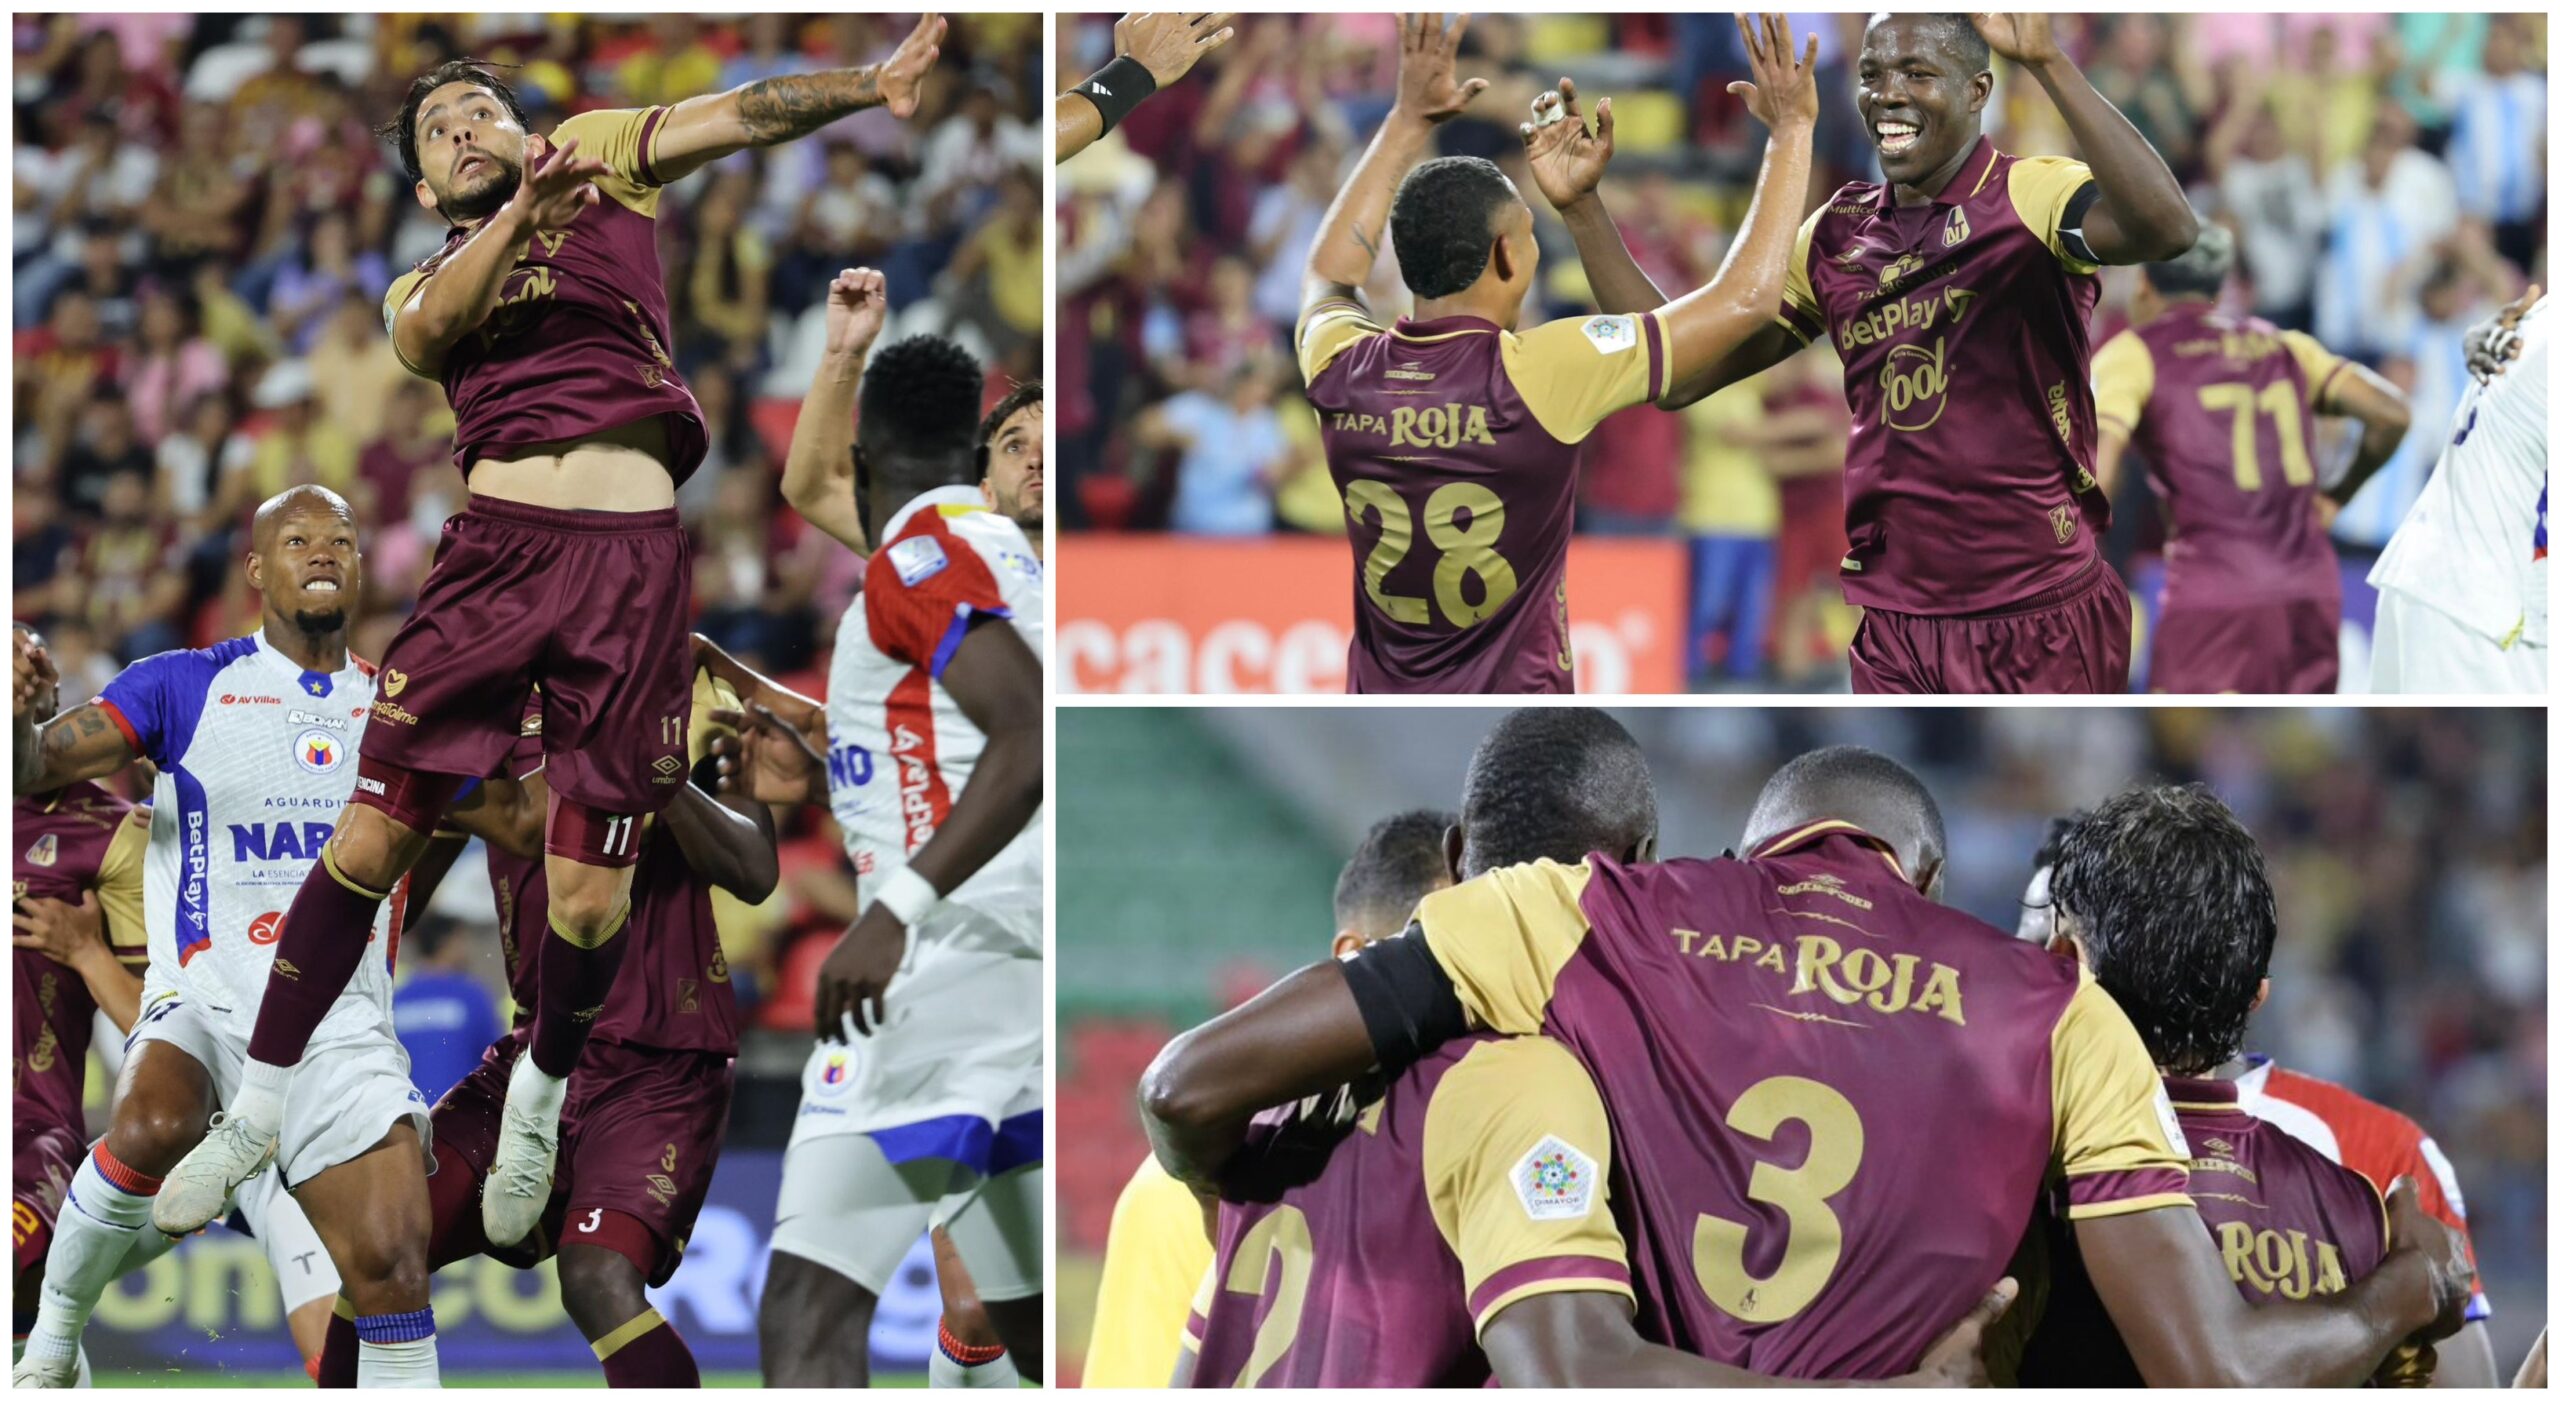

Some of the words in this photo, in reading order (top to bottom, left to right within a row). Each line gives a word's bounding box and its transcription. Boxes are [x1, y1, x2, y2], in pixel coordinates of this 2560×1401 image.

[1841, 297, 1940, 350] BetPlay
[1880, 336, 1949, 425] Pool
[1333, 412, 1387, 436] TAPA
[1389, 402, 1497, 448] ROJA
[2199, 379, 2315, 492] 71
[1345, 478, 1518, 629] 28
[252, 694, 282, 705] Villas
[660, 716, 681, 746] 11
[184, 811, 206, 911] BetPlay
[603, 815, 633, 856] 11
[252, 870, 265, 878] LA
[1670, 928, 1786, 973] TAPA
[1789, 934, 1966, 1026] ROJA
[661, 1143, 677, 1172] 3
[578, 1208, 603, 1233] 3
[1692, 1075, 1864, 1323] 3
[2216, 1221, 2348, 1300] ROJA
